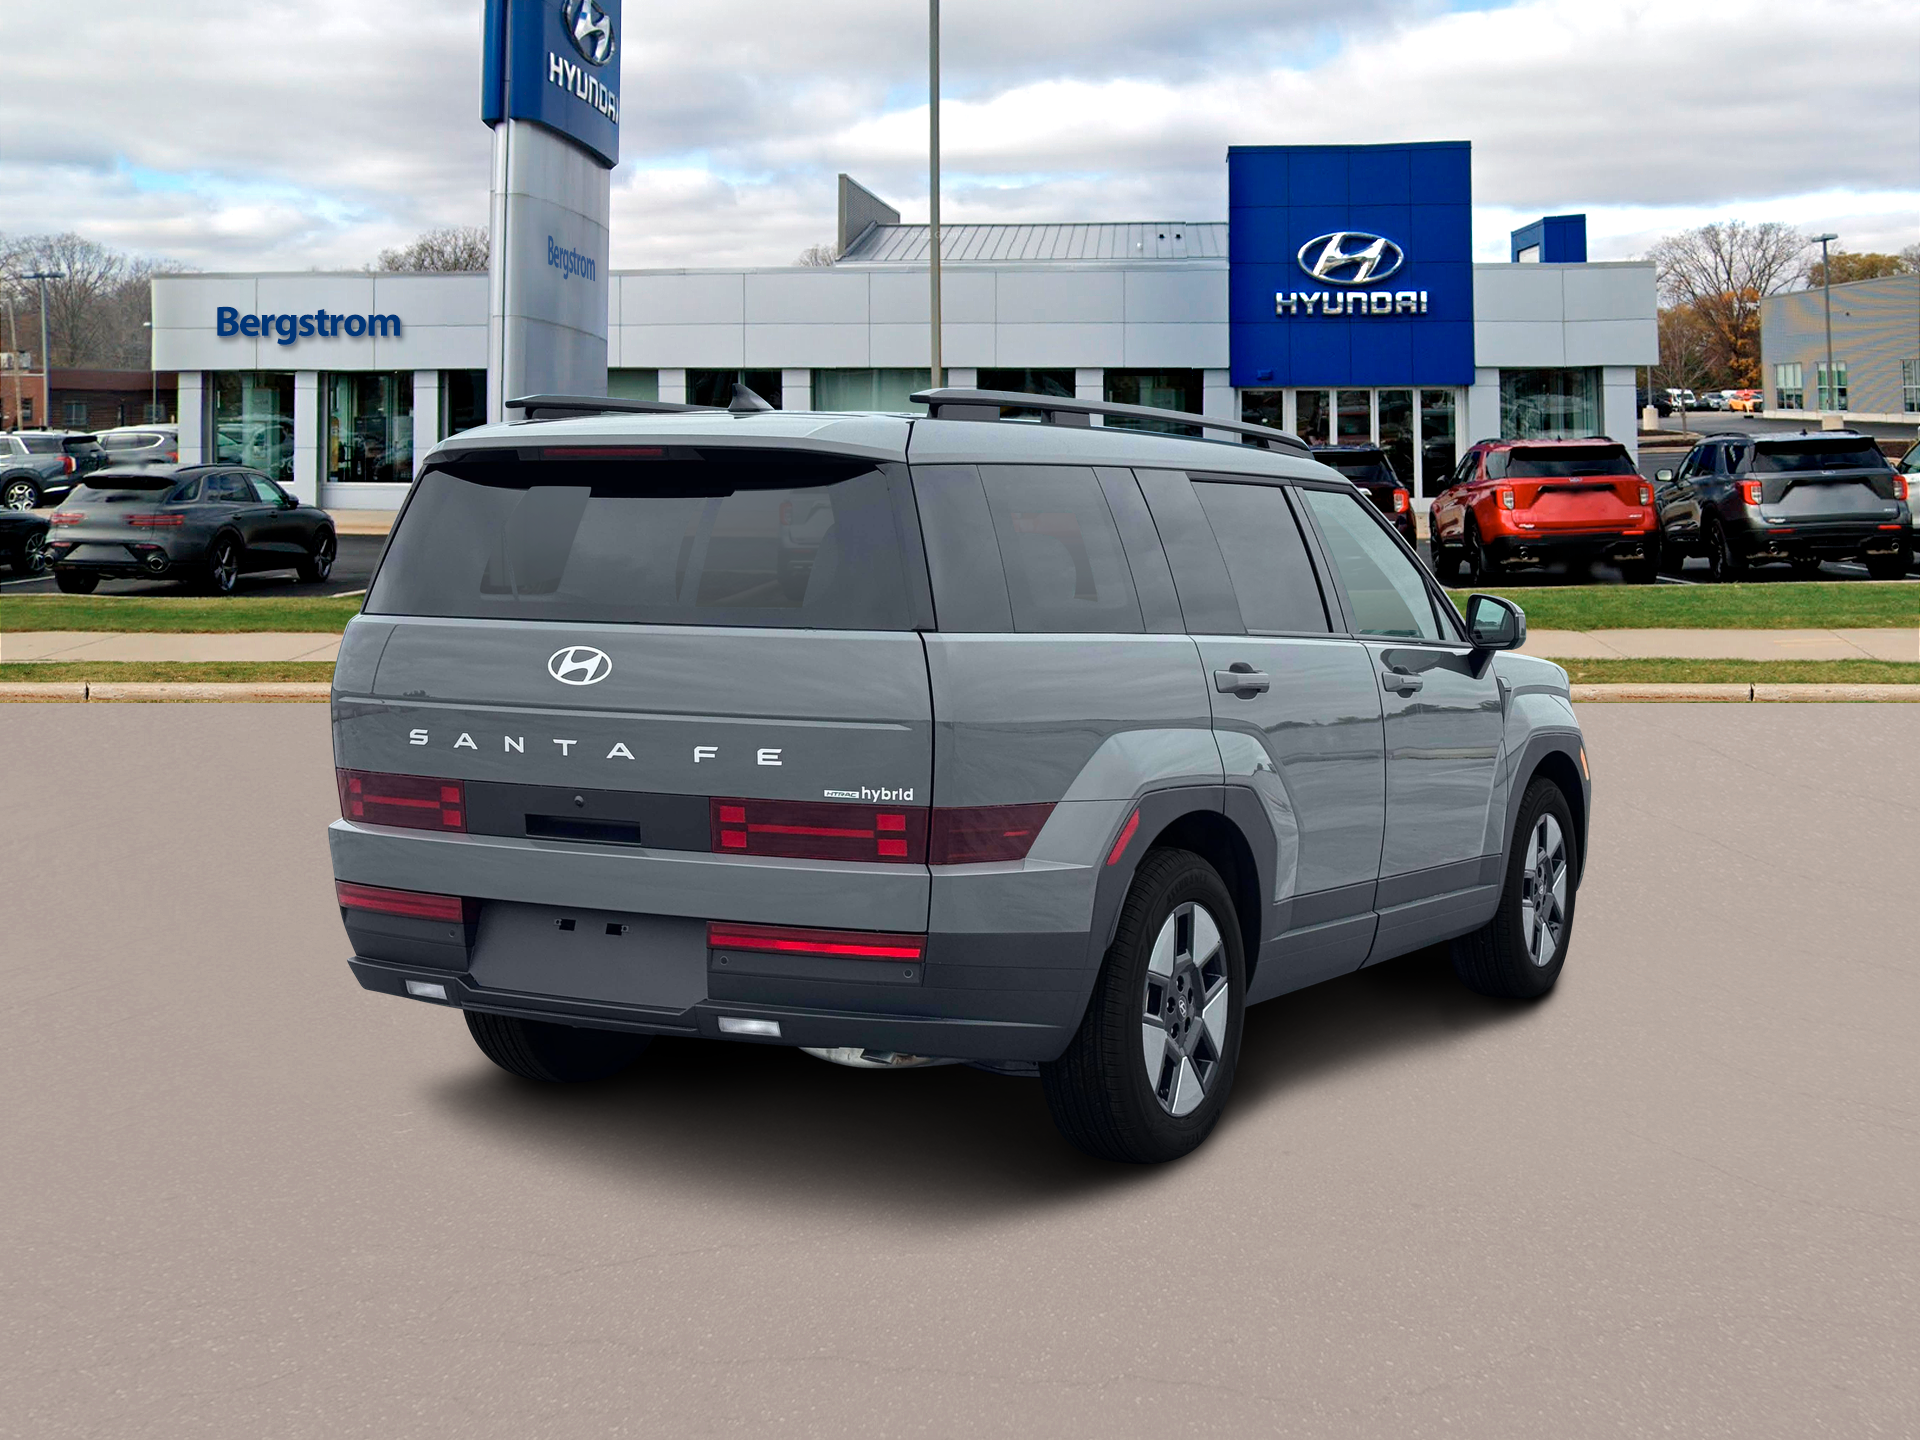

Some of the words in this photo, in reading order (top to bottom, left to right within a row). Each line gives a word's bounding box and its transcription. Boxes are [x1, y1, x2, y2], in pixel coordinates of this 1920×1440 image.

[549, 52, 619, 124] HYUNDAI
[548, 235, 596, 281] Bergstrom
[1276, 290, 1428, 315] HYUNDAI
[217, 306, 401, 345] Bergstrom
[409, 728, 635, 760] SANTA
[693, 746, 783, 766] FE
[825, 790, 859, 798] HTRAC
[861, 786, 914, 802] hybrid
